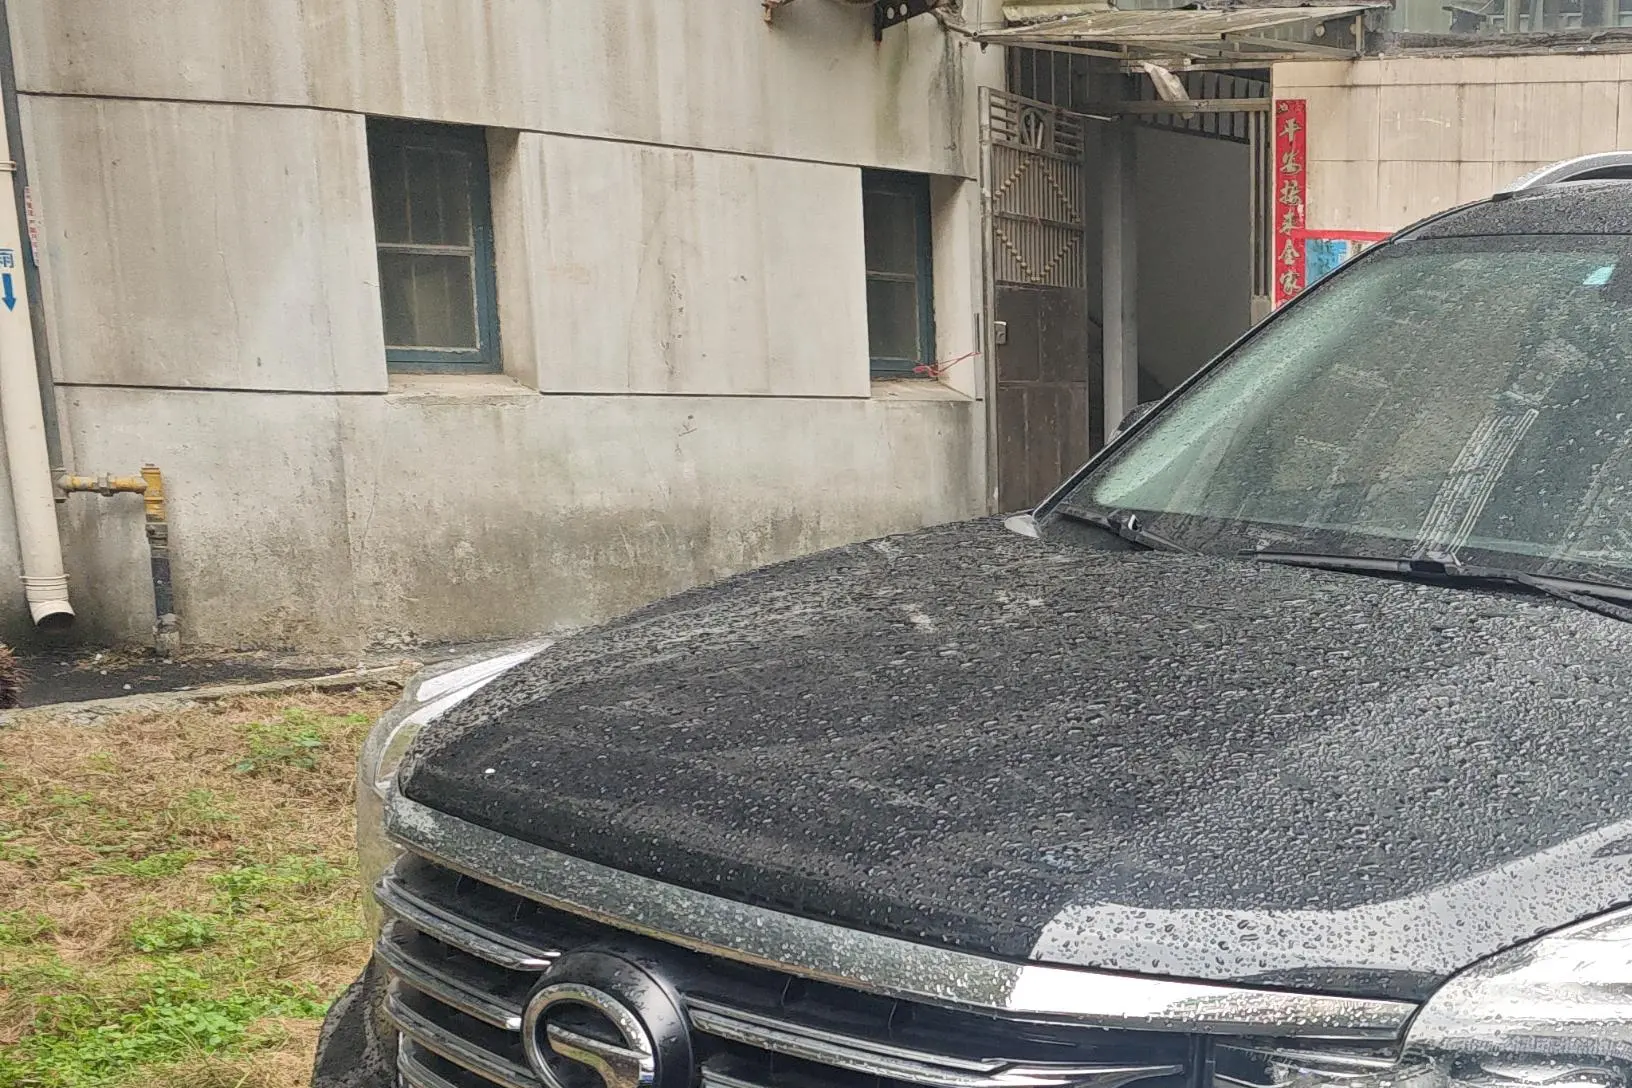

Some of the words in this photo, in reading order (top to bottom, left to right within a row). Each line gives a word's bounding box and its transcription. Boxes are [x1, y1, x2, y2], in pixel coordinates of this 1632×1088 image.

[1278, 117, 1305, 302] 平安接来全家
